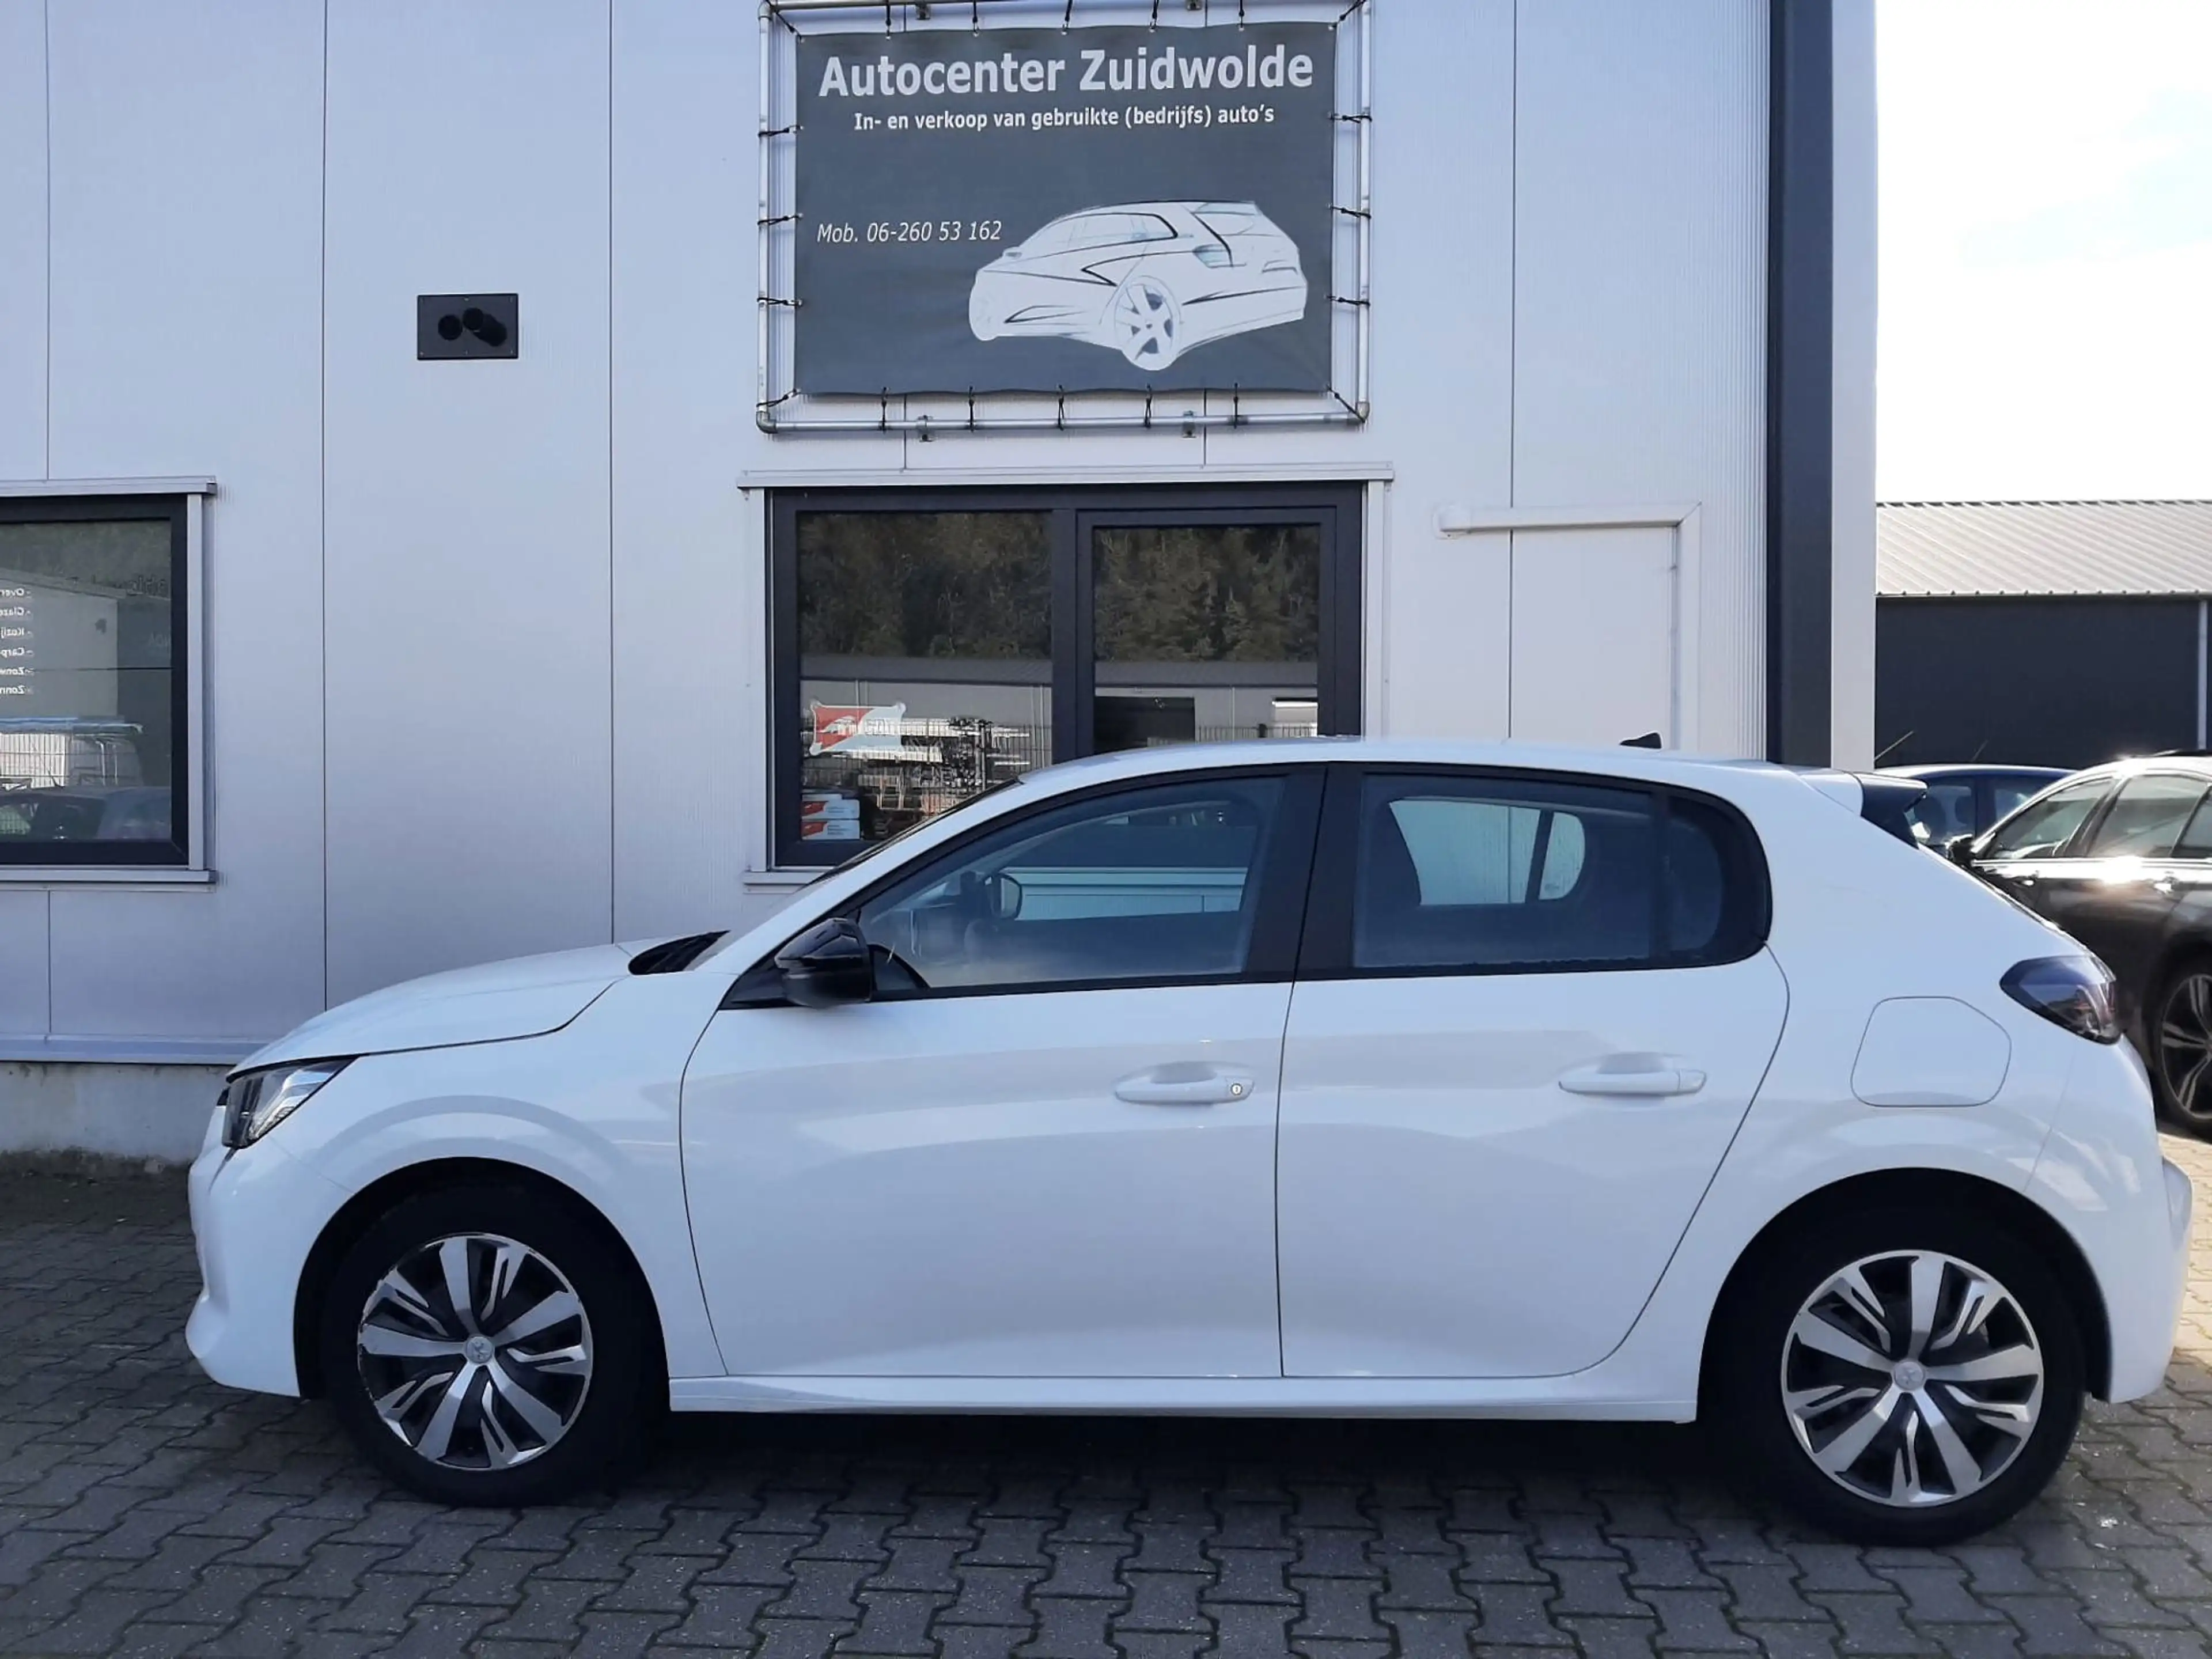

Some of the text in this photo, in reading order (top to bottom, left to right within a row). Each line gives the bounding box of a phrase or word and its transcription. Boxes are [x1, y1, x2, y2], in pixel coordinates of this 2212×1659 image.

[818, 44, 1313, 97] Autocenter Zuidwolde
[854, 113, 882, 130] In-
[888, 115, 908, 129] en
[915, 111, 987, 131] verkoop
[993, 112, 1025, 127] van
[1031, 108, 1119, 130] gebruikte
[1125, 105, 1211, 128] (bedrijfs)
[817, 219, 1002, 243] Mob. 06-260 53 162
